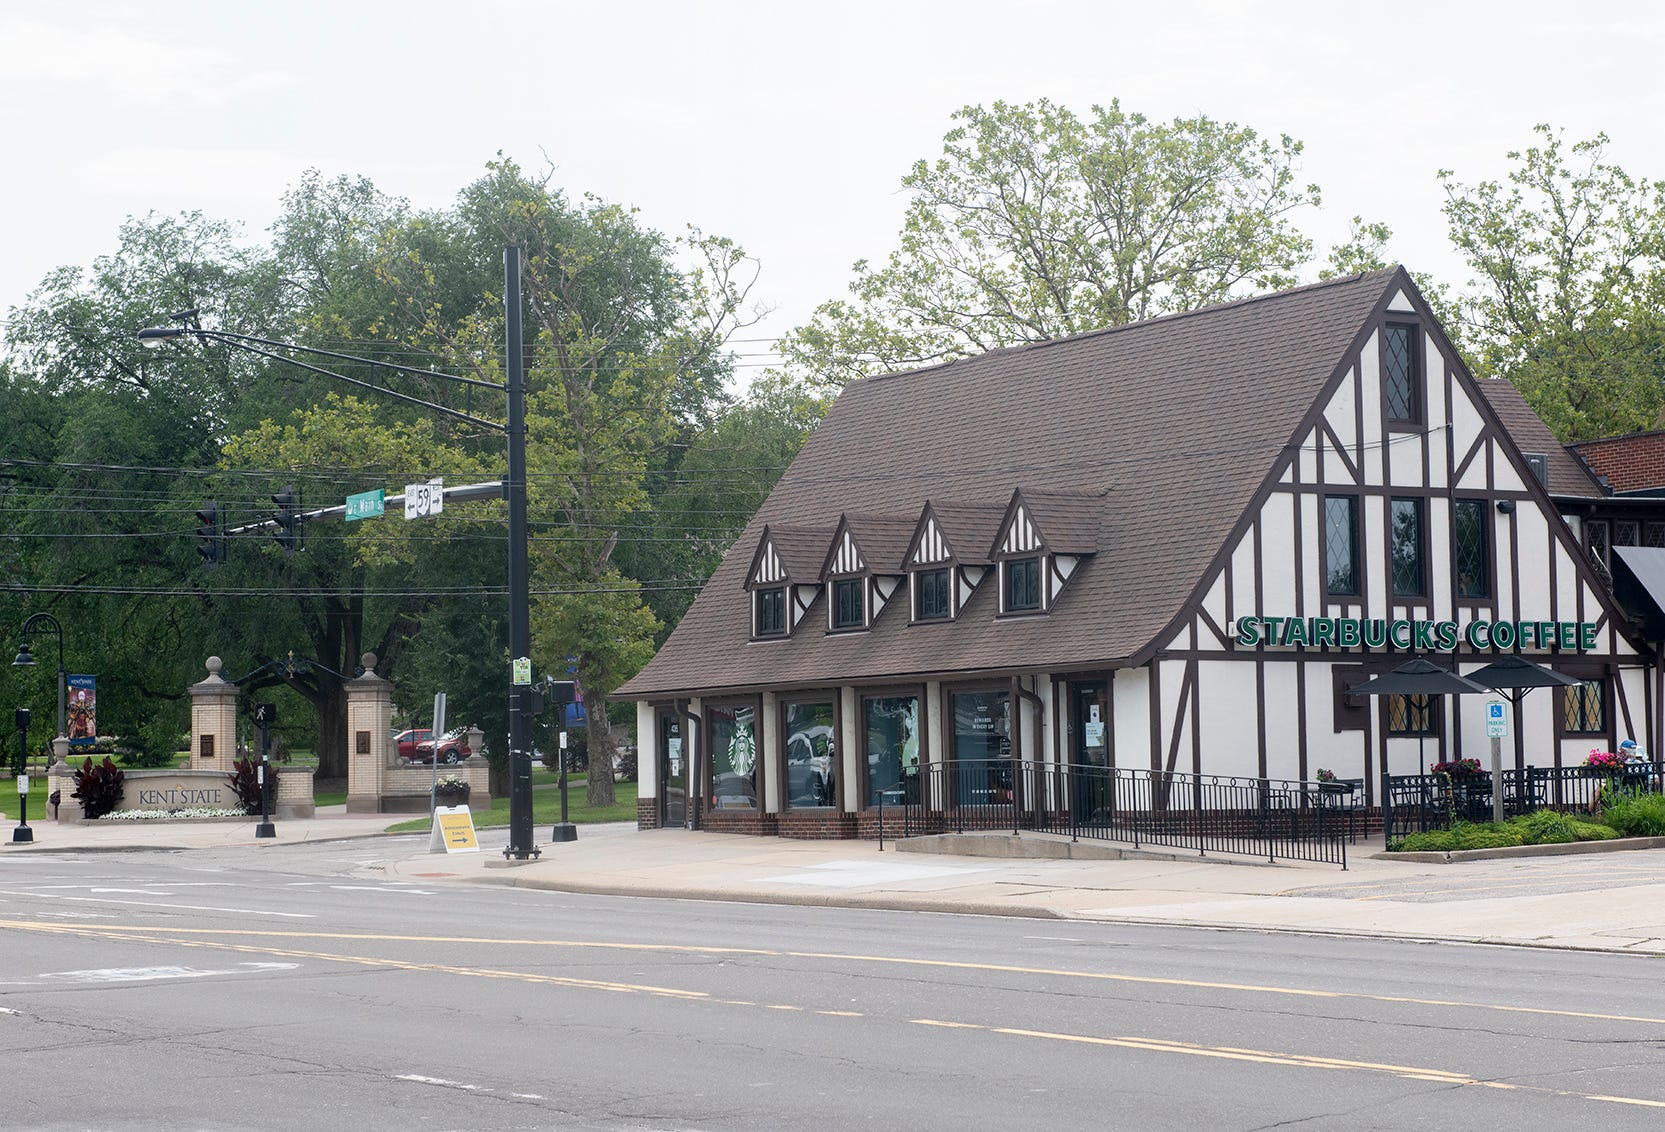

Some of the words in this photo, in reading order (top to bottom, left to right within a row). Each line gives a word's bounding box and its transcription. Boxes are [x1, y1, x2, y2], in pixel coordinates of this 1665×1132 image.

[360, 499, 375, 513] Main
[418, 488, 429, 508] 59
[1238, 616, 1457, 650] STARBUCKS
[1467, 621, 1597, 650] COFFEE
[139, 789, 178, 804] KENT
[180, 789, 221, 804] STATE
